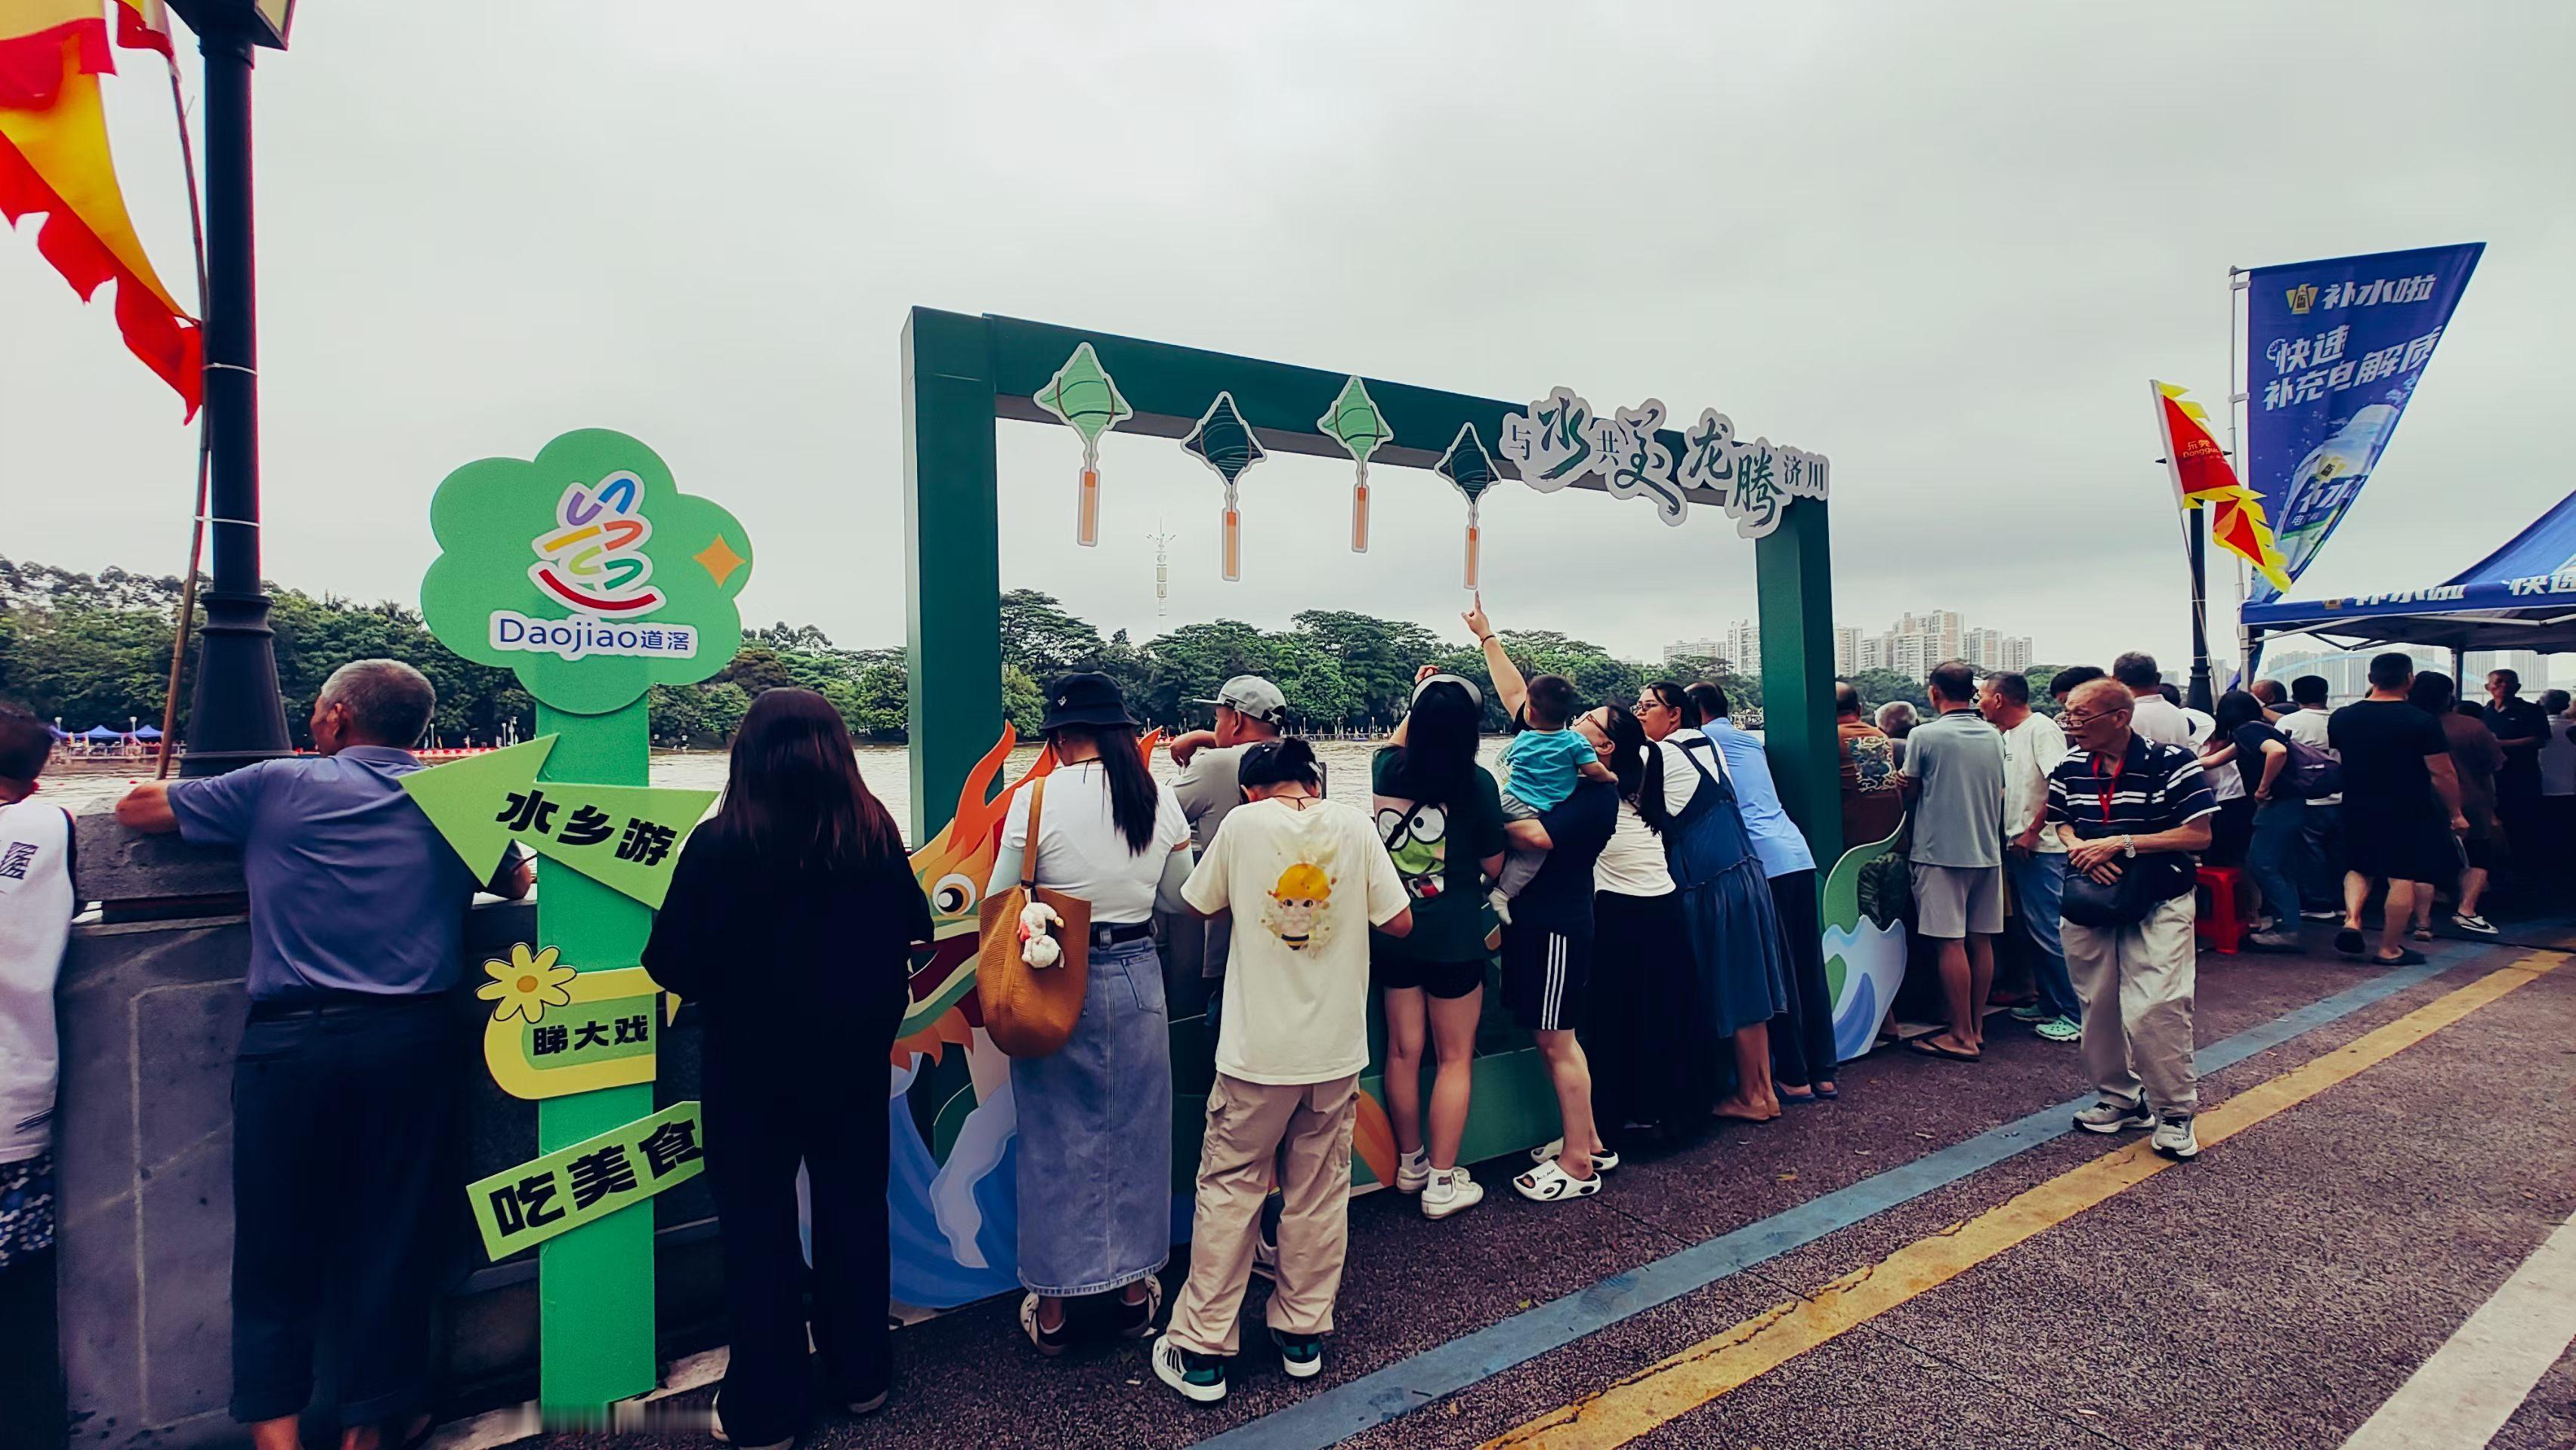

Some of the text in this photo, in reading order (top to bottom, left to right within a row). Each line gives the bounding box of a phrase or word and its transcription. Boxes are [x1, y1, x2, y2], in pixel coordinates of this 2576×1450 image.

[2322, 274, 2437, 310] 补水啦
[2275, 324, 2351, 375] 快速
[495, 789, 678, 866] 水乡游
[533, 1014, 649, 1056] 睇大戏
[489, 1118, 703, 1238] 吃美食
